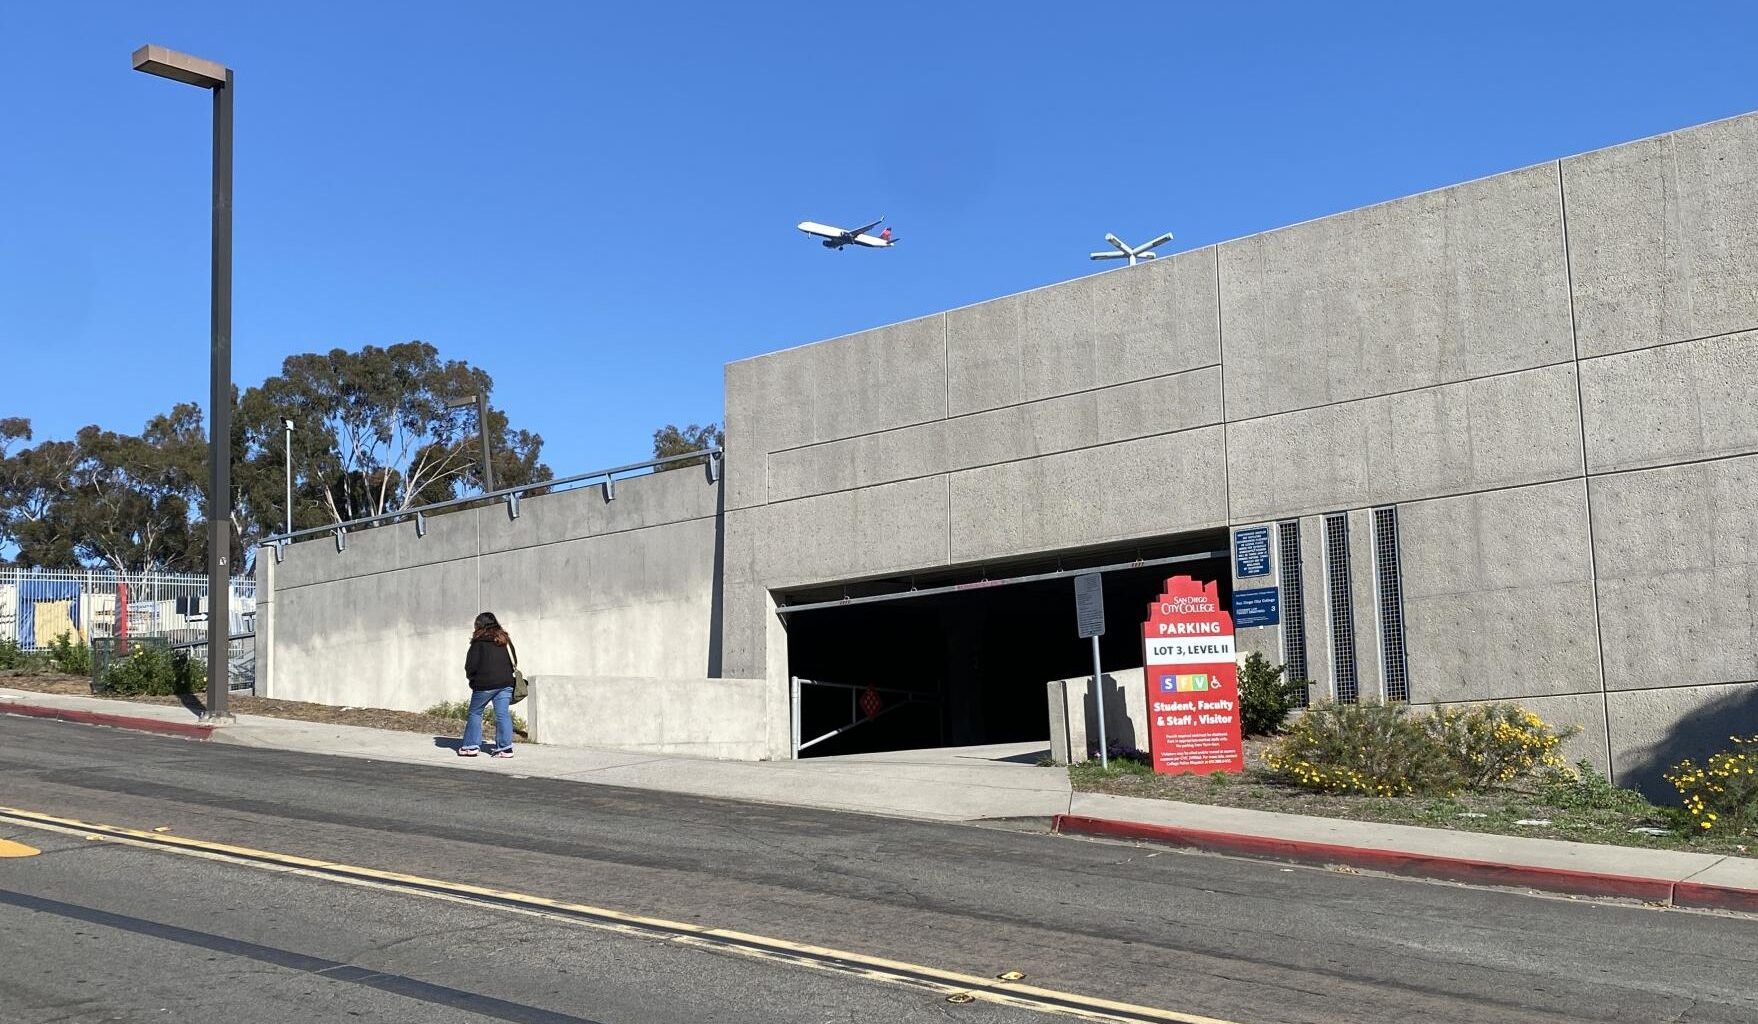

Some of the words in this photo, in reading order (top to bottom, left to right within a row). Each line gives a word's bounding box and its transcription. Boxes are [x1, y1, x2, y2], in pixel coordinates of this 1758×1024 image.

[1173, 596, 1187, 605] SAN
[1187, 596, 1207, 604] DIEGO
[1159, 621, 1220, 635] PARKING
[1154, 646, 1174, 656] LOT
[1176, 646, 1186, 656] 3,
[1188, 645, 1219, 655] LEVEL
[1221, 644, 1228, 654] II
[1164, 678, 1173, 690] S
[1195, 677, 1205, 689] V
[1153, 701, 1196, 712] Student,
[1197, 700, 1233, 711] Faculty
[1157, 716, 1166, 727] &
[1198, 714, 1233, 725] Visitor
